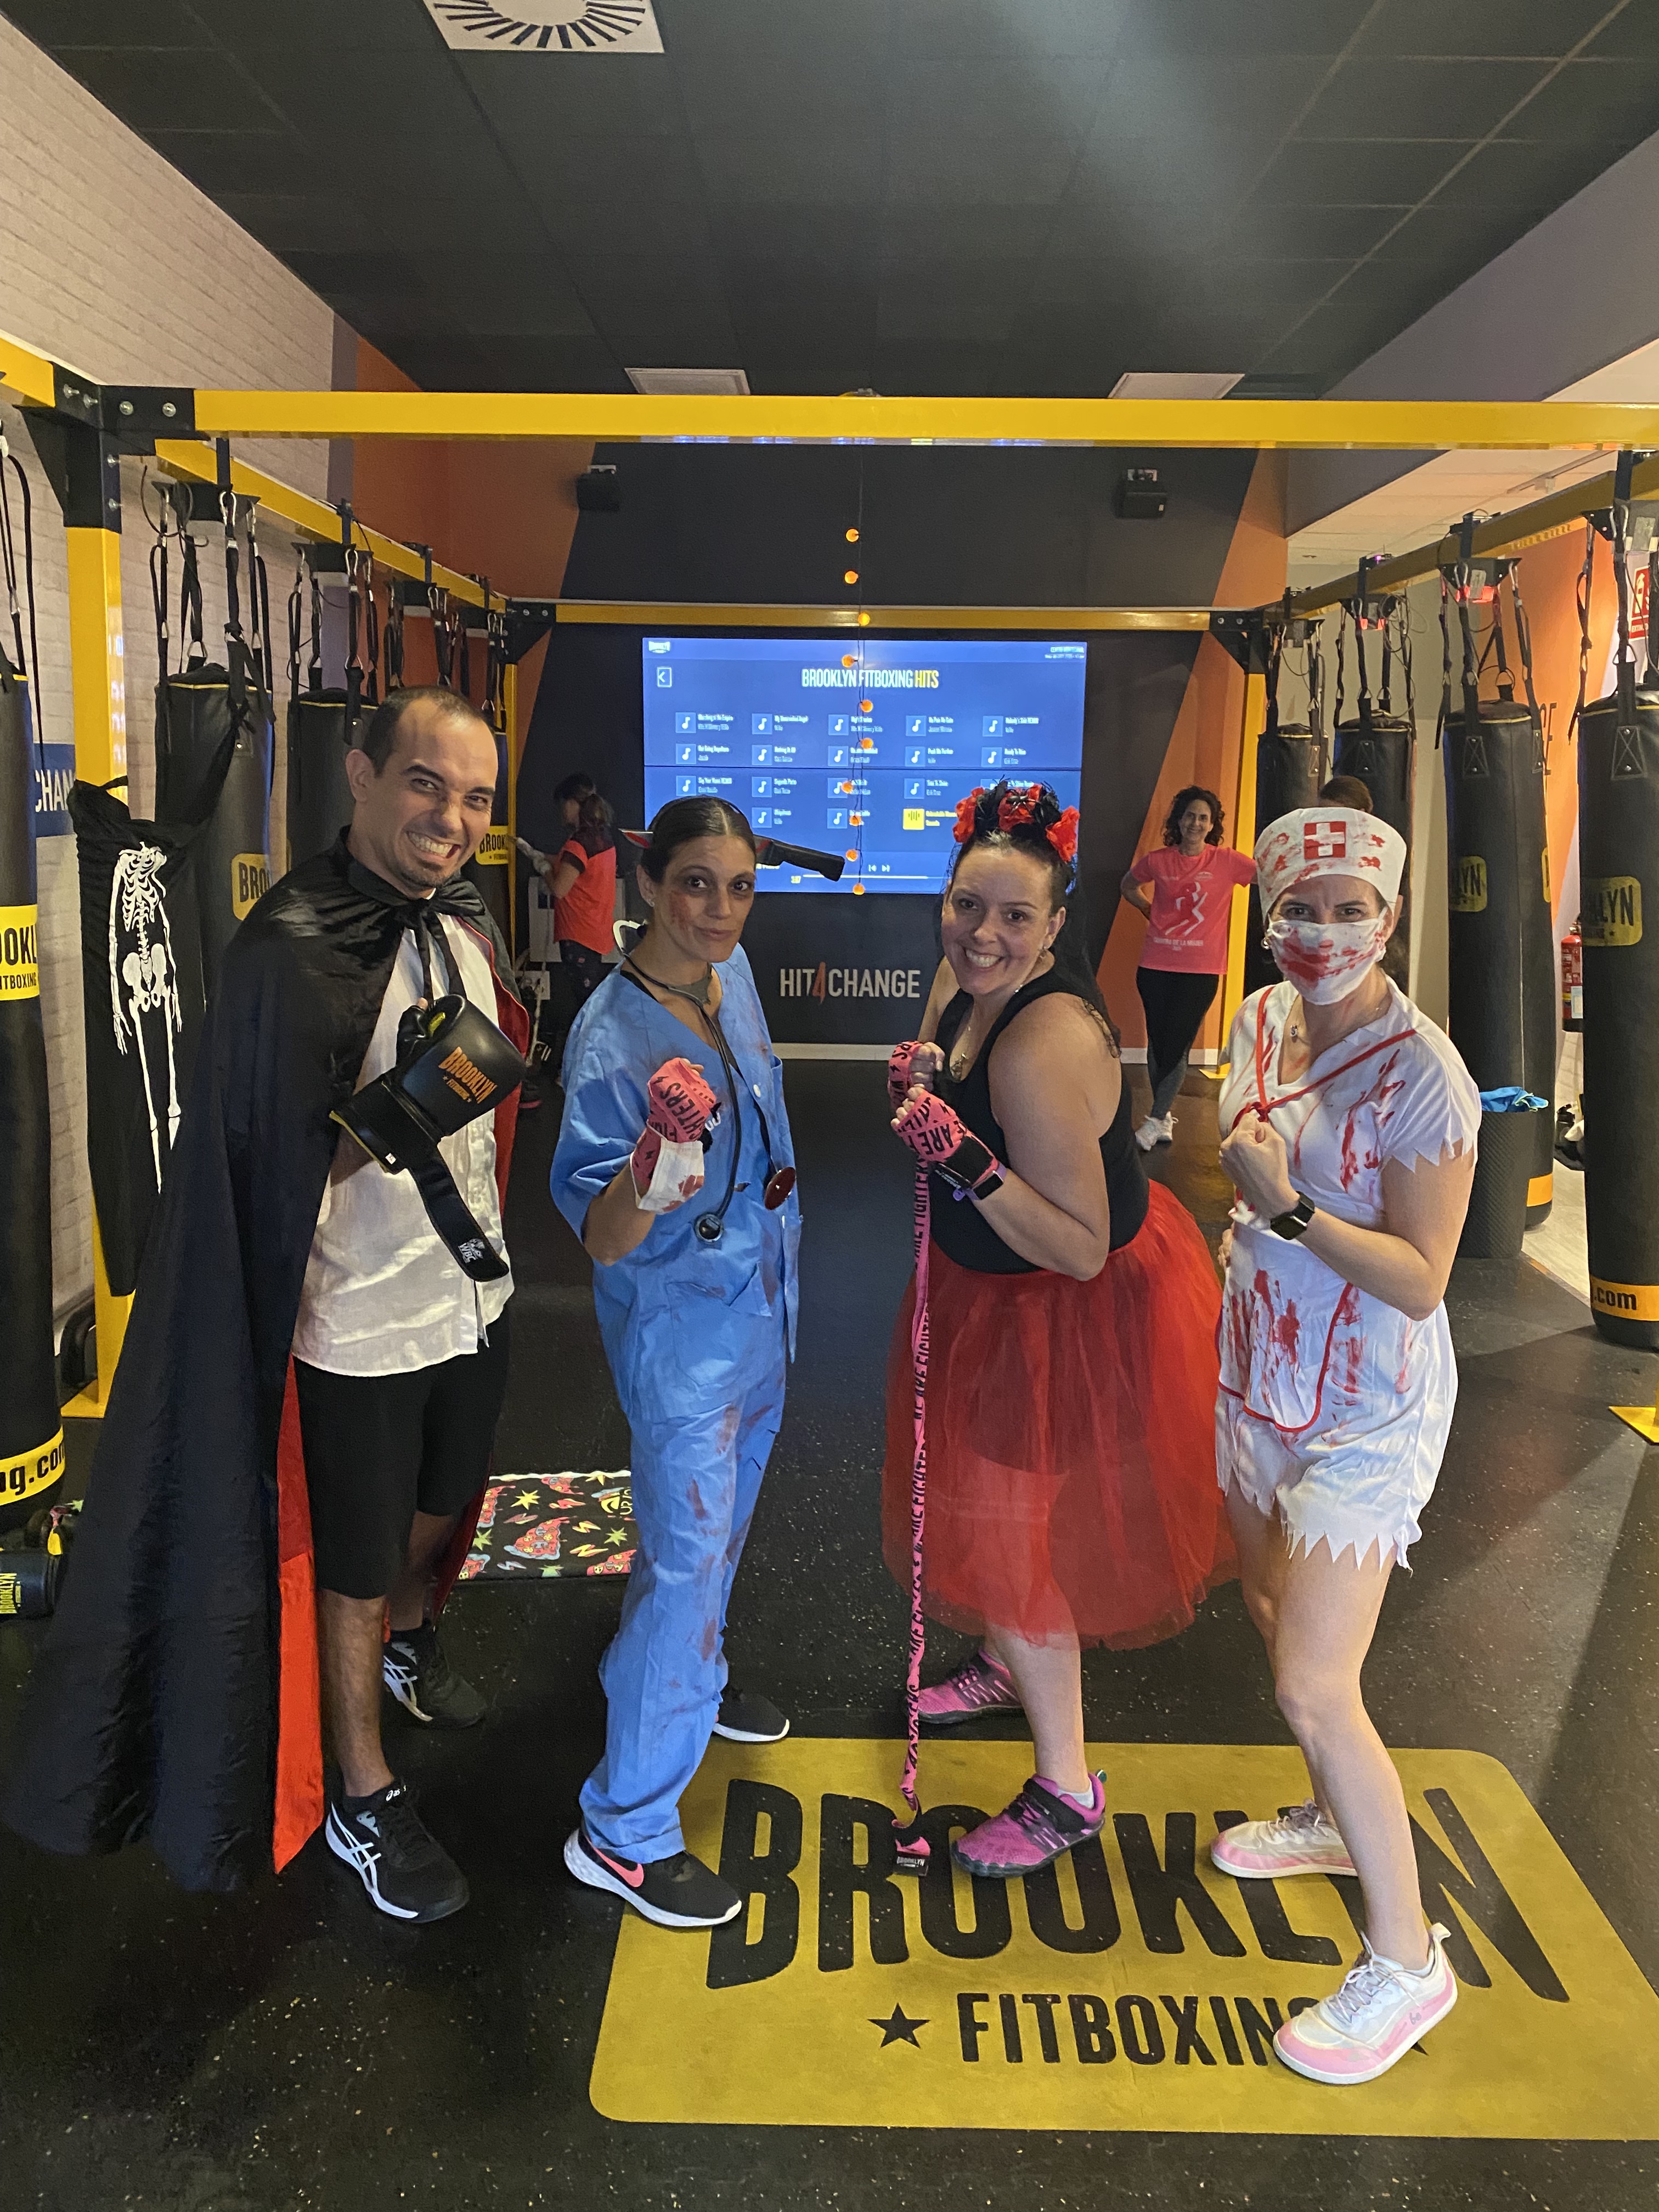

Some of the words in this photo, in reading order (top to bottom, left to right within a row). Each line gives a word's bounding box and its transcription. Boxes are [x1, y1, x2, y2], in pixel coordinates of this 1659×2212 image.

[802, 669, 856, 687] BROOKLYN
[859, 669, 913, 688] FITBOXING
[915, 670, 939, 689] HITS
[0, 925, 37, 966] OKL
[438, 1046, 498, 1104] BROOKLYN
[460, 1243, 476, 1262] WBC
